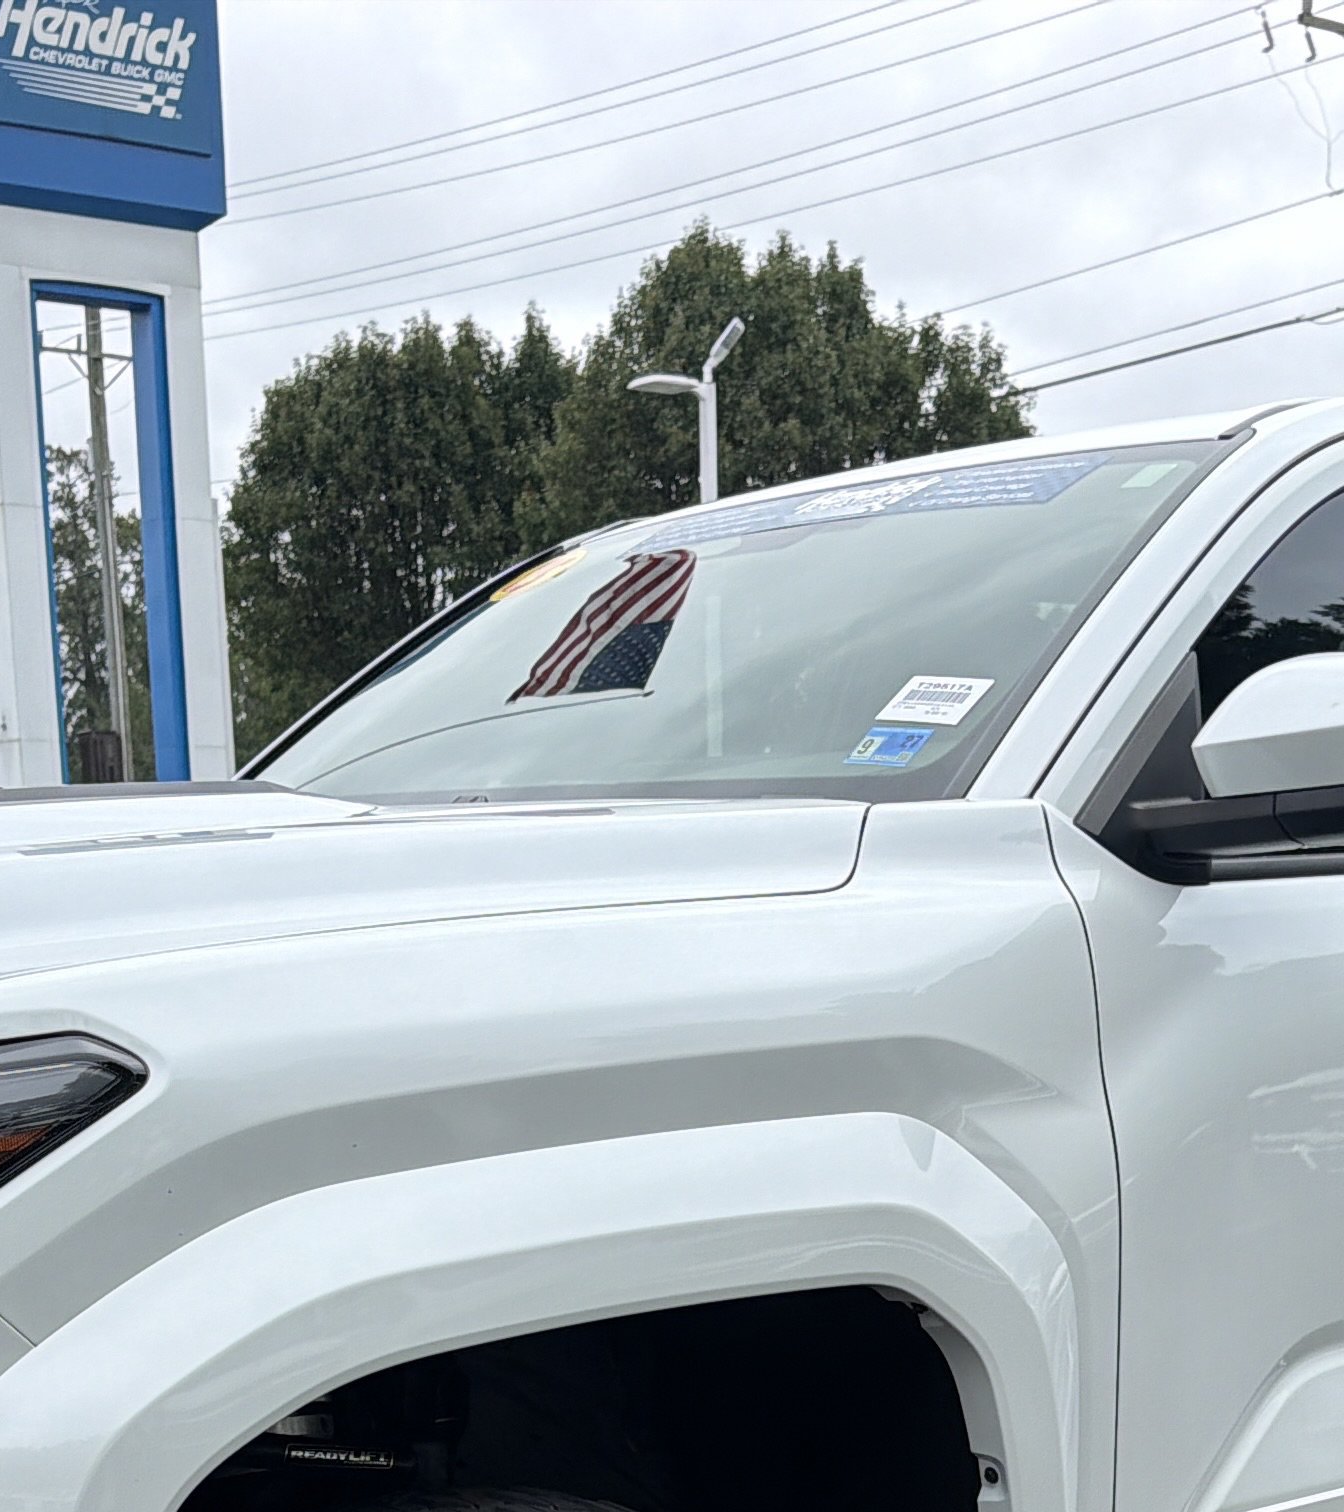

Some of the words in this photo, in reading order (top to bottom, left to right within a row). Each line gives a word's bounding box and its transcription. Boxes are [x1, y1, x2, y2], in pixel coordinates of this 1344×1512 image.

[28, 46, 107, 73] CHEVROLET
[110, 61, 152, 81] BUICK
[153, 68, 186, 86] GMC
[856, 738, 875, 755] 9
[290, 1450, 389, 1462] READYLIFT
